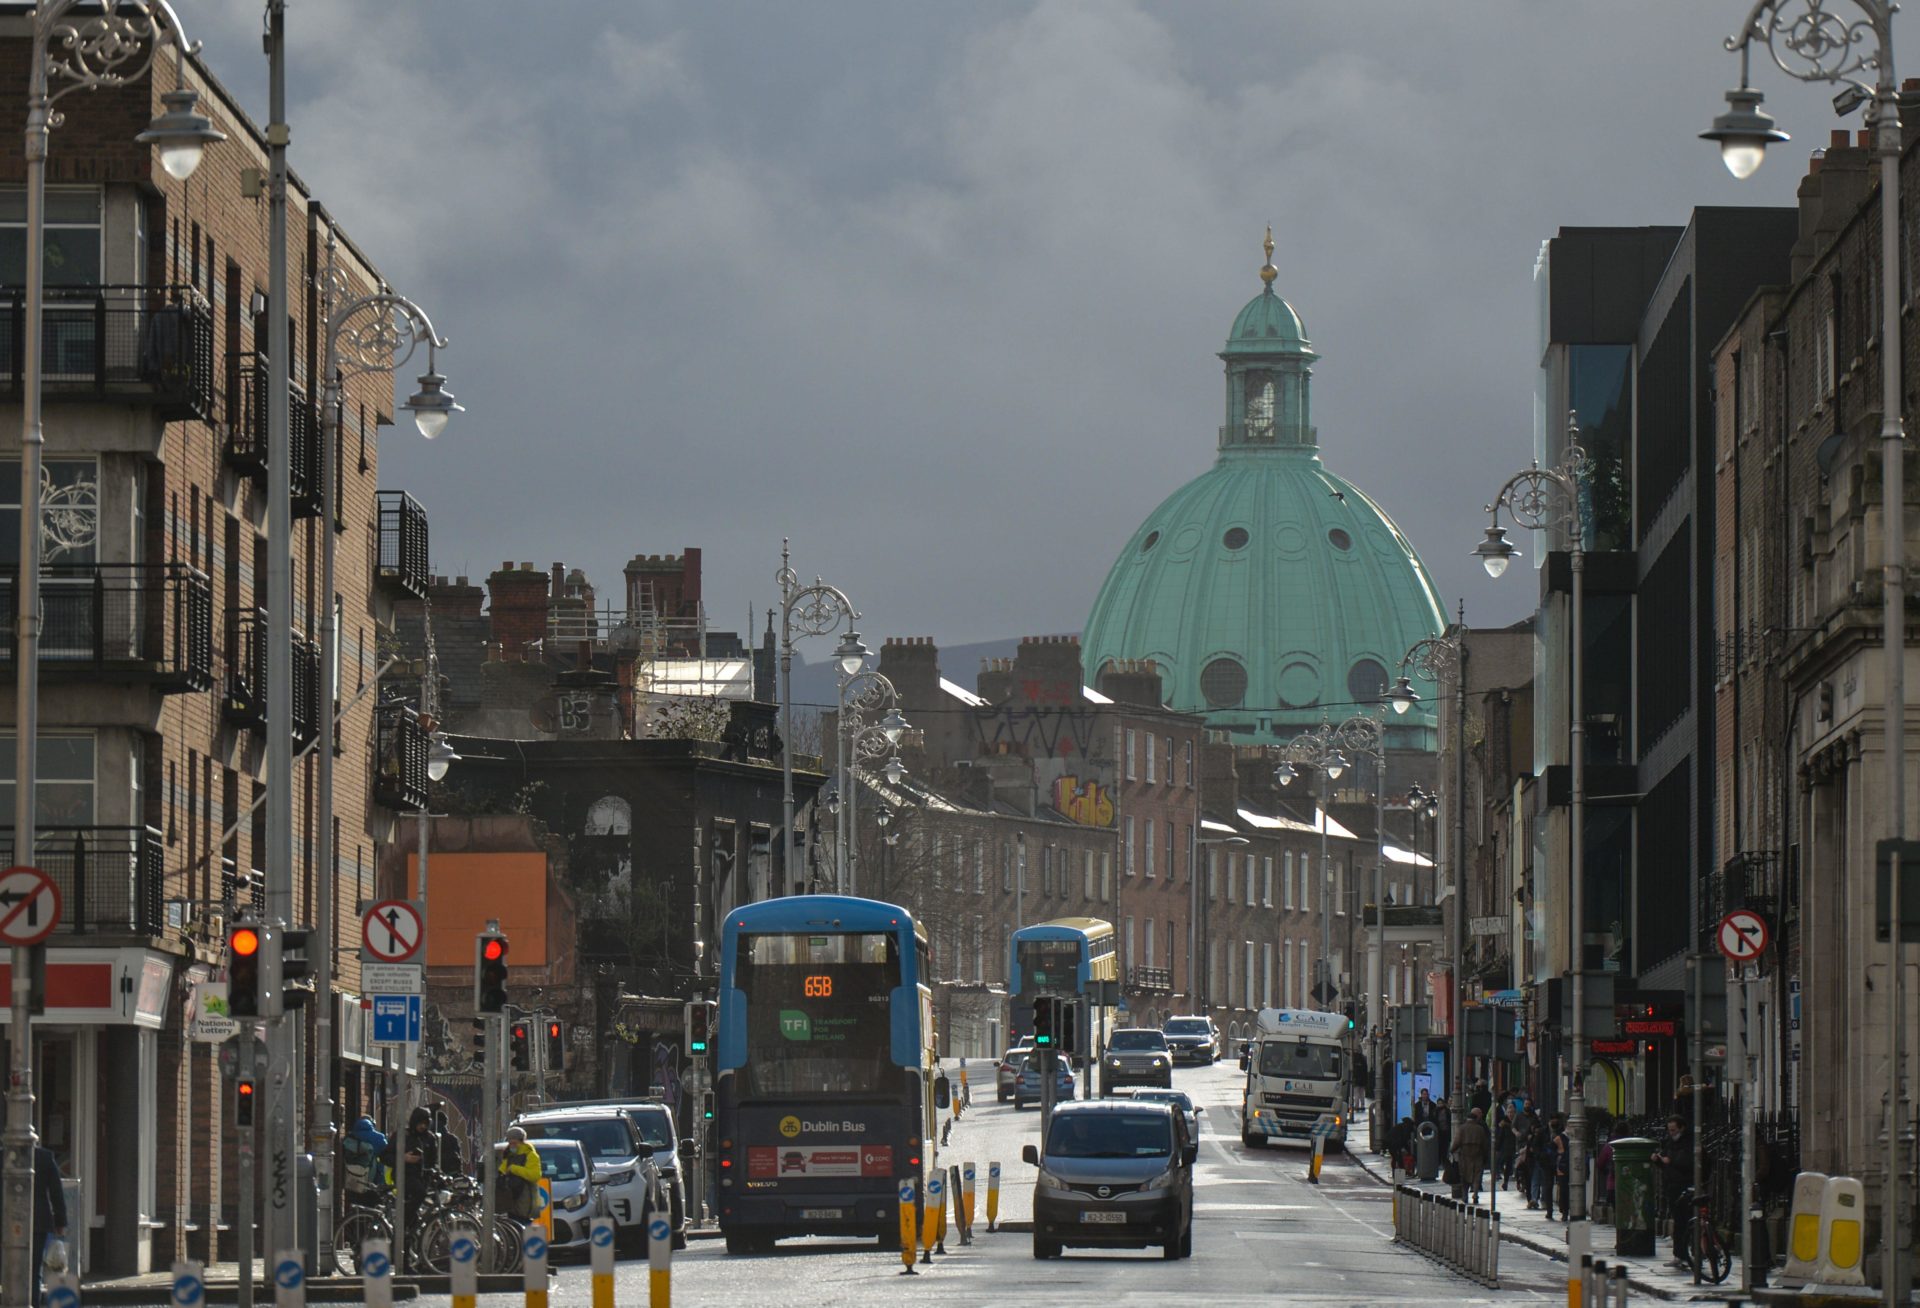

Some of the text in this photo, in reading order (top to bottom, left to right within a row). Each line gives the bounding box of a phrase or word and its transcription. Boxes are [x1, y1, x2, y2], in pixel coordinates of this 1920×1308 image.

[805, 976, 832, 997] 65B
[200, 1027, 232, 1035] Lottery
[784, 1020, 807, 1031] TFI
[802, 1121, 866, 1132] Dublin Bus
